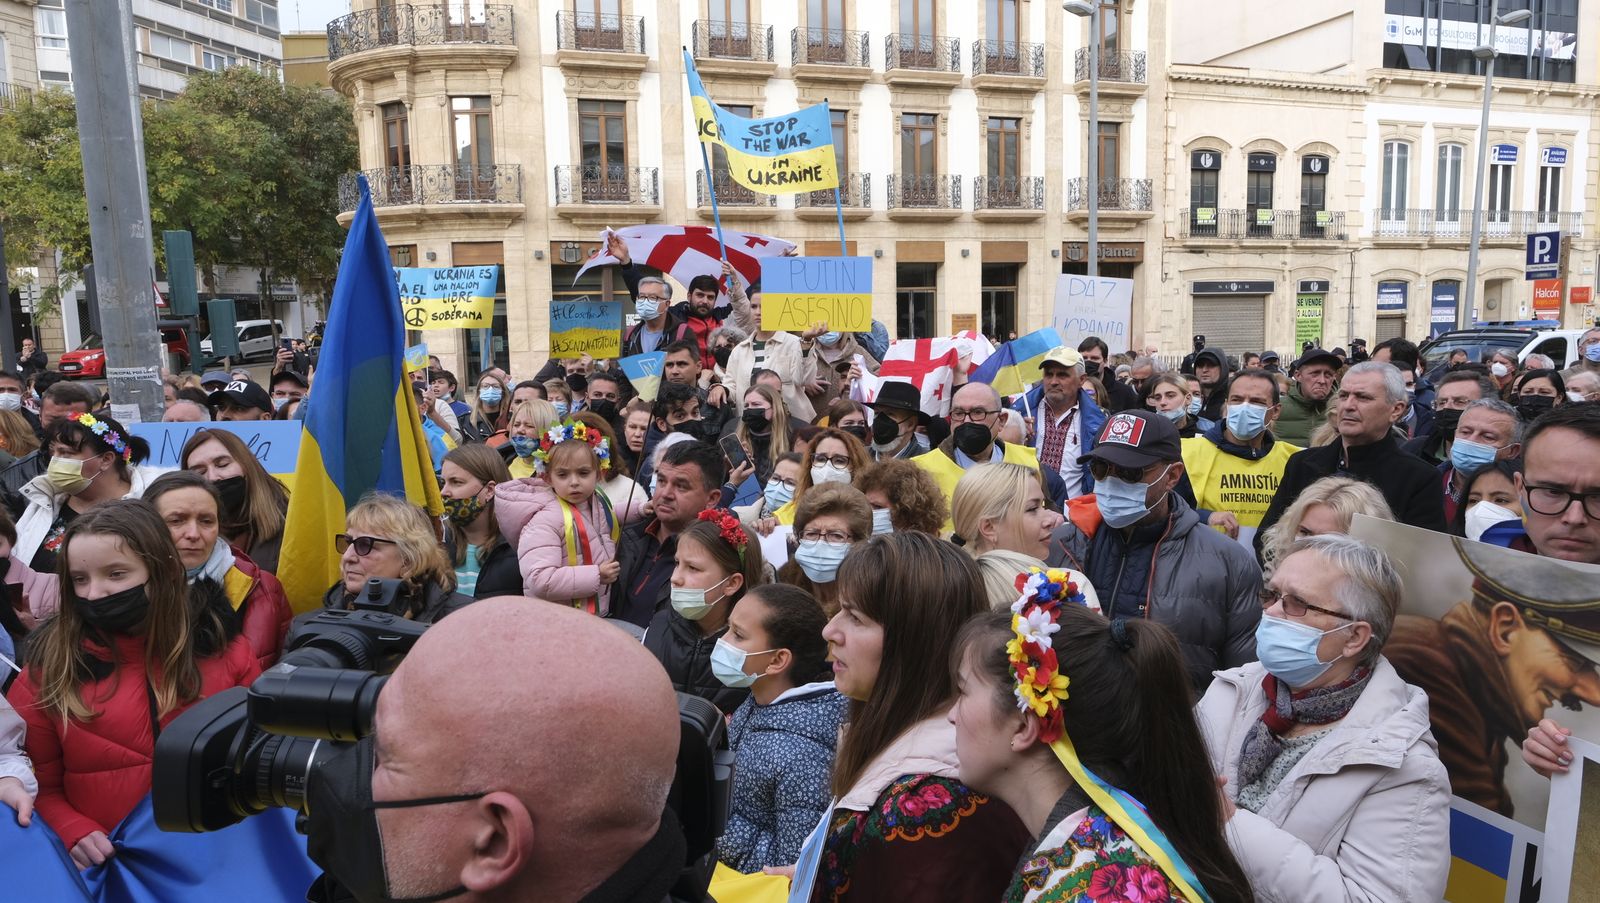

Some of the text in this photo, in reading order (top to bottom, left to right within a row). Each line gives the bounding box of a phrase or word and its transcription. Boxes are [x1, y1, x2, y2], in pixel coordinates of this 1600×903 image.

[1494, 34, 1528, 46] BOGADOS
[748, 117, 799, 137] STOP
[741, 132, 812, 152] THE WAR
[1090, 244, 1138, 259] ajamar
[1534, 236, 1551, 263] P
[434, 269, 492, 280] UCRANIA ES
[790, 259, 856, 291] PUTIN
[413, 284, 427, 295] EL
[433, 281, 479, 291] UNA NACION
[442, 291, 473, 303] LIBRE
[1068, 278, 1118, 308] PAZ
[452, 304, 457, 313] Y
[1297, 298, 1322, 307] SE VENDE
[431, 310, 483, 321] SOBERANA
[778, 297, 864, 329] ASESINO
[1302, 309, 1322, 318] ALQUILA
[1220, 472, 1279, 490] AMNISTÍA
